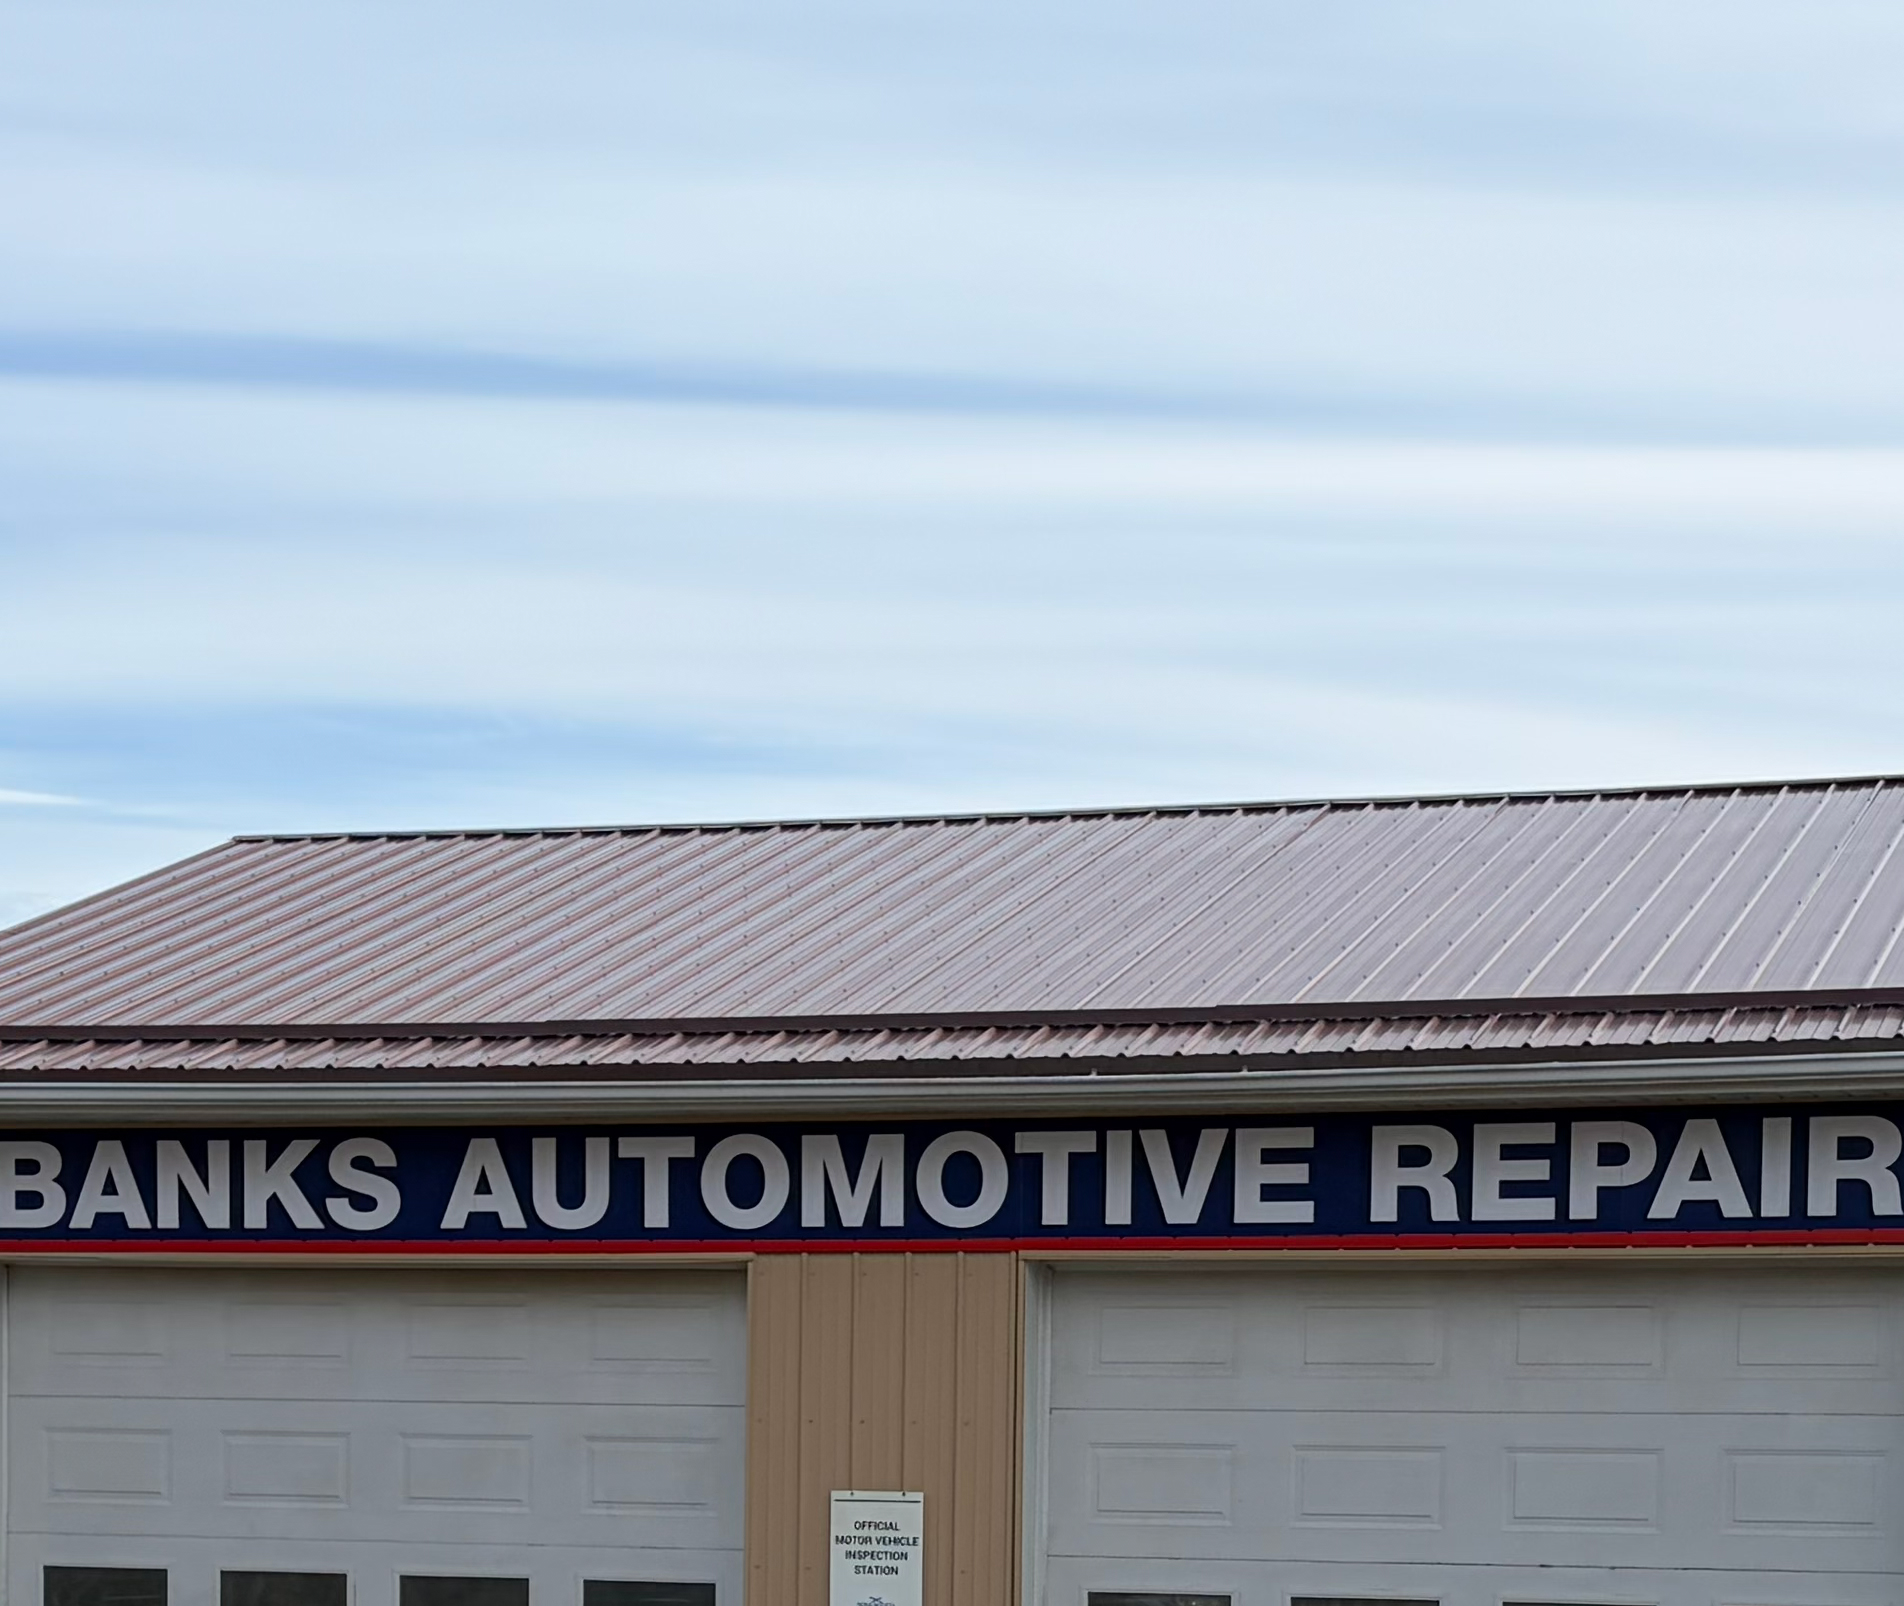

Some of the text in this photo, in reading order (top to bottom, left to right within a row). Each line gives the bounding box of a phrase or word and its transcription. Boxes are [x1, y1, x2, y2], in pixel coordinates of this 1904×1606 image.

[439, 1126, 1314, 1231] AUTOMOTIVE
[1368, 1115, 1904, 1224] REPAIR
[854, 1520, 900, 1531] OFFICIAL
[835, 1535, 919, 1546] MOTOR VEHICLE
[845, 1550, 908, 1560] INSPECTION
[854, 1565, 899, 1575] STATION
